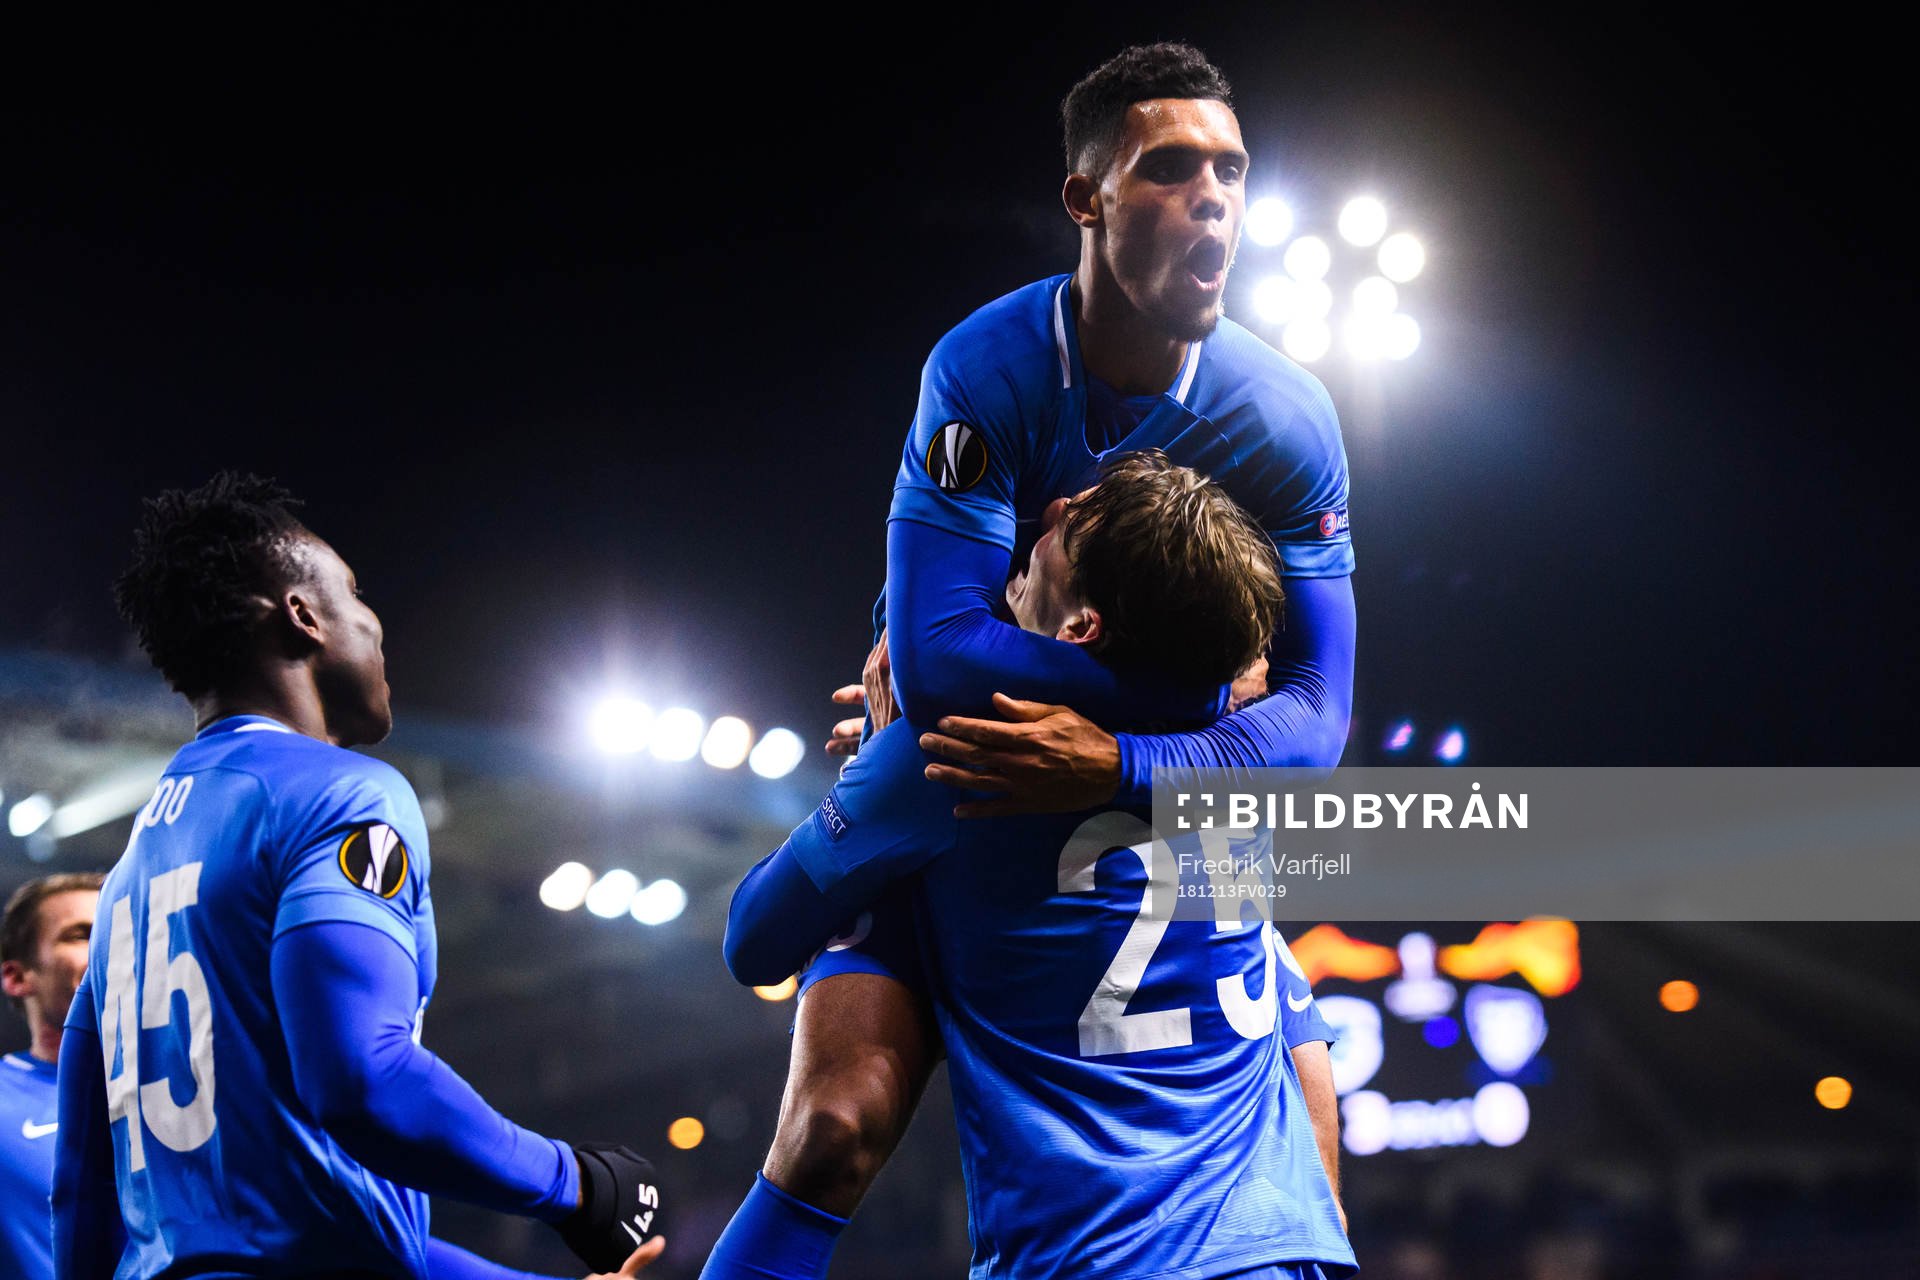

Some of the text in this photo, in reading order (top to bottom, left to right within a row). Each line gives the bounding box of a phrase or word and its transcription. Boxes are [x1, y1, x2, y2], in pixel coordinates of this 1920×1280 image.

[822, 796, 847, 834] SPECT
[1057, 810, 1277, 1058] 25
[100, 861, 217, 1174] 45
